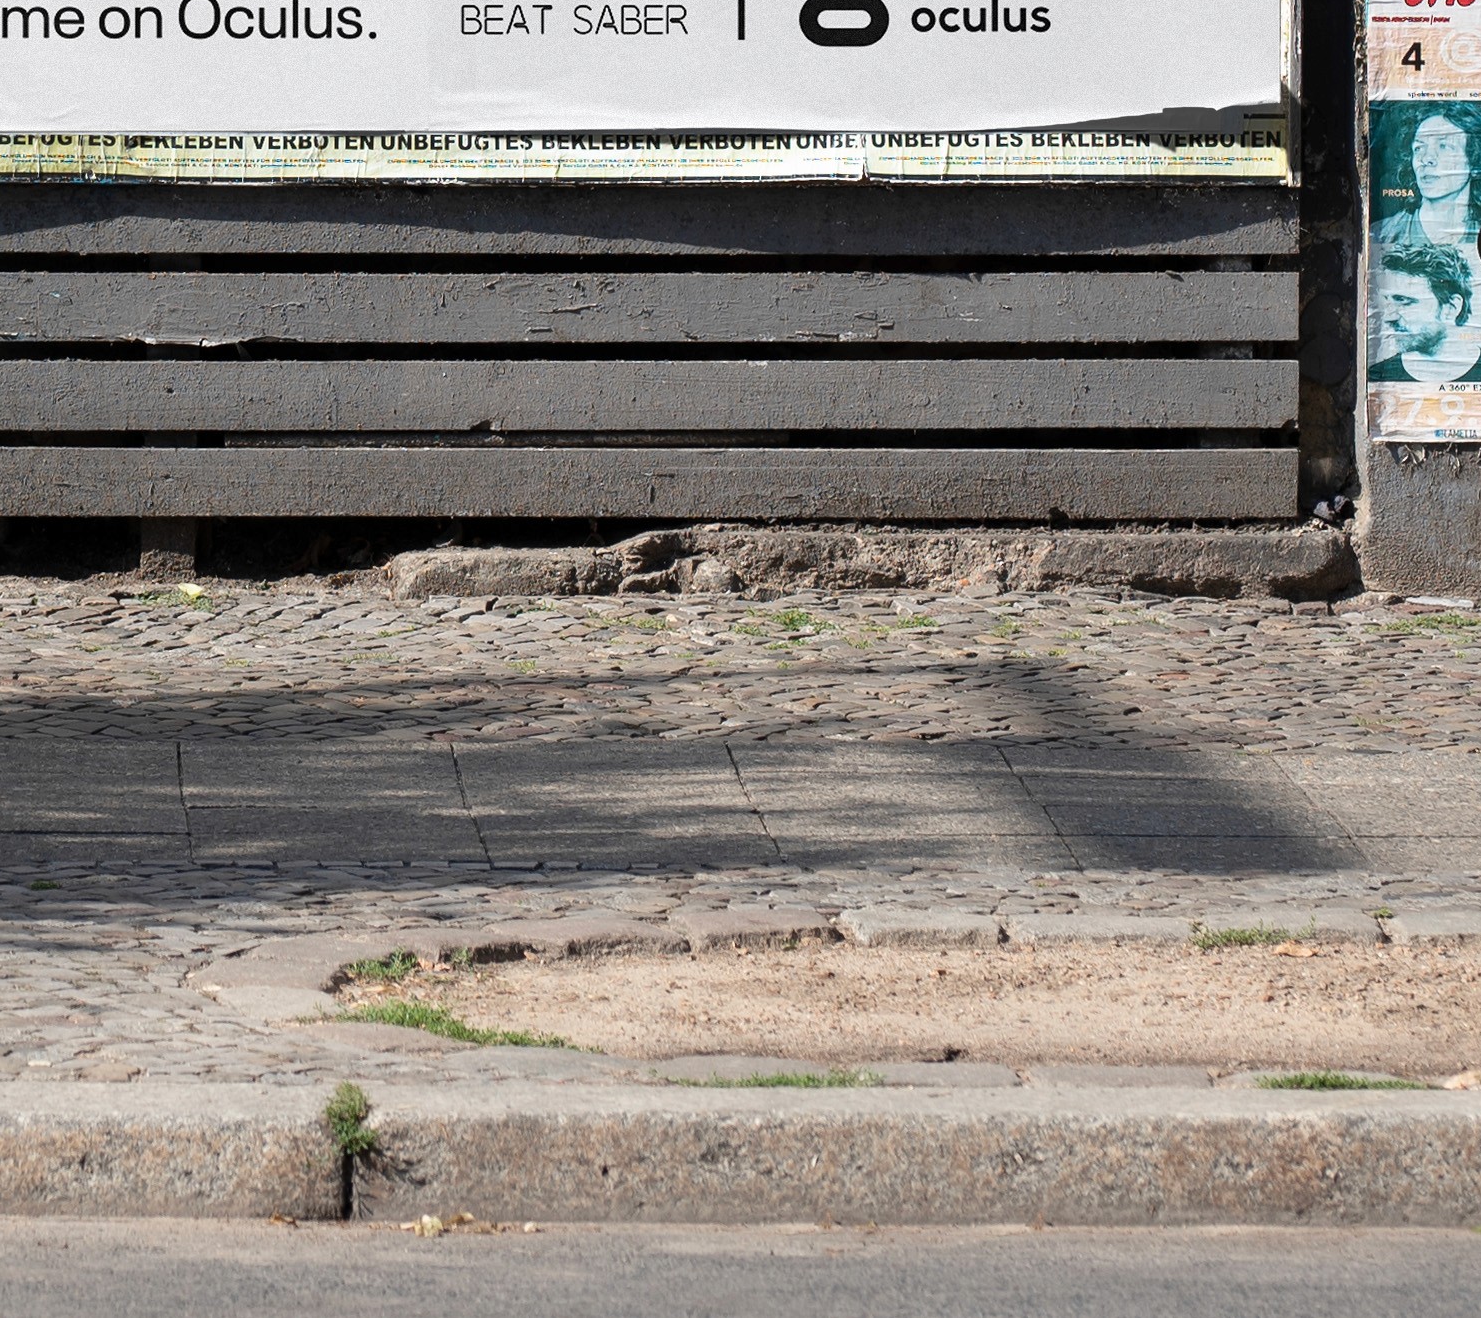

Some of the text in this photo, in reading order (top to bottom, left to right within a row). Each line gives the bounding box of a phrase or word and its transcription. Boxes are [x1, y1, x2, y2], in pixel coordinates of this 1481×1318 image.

[97, 5, 163, 41] on
[459, 4, 688, 36] BEAT SABER
